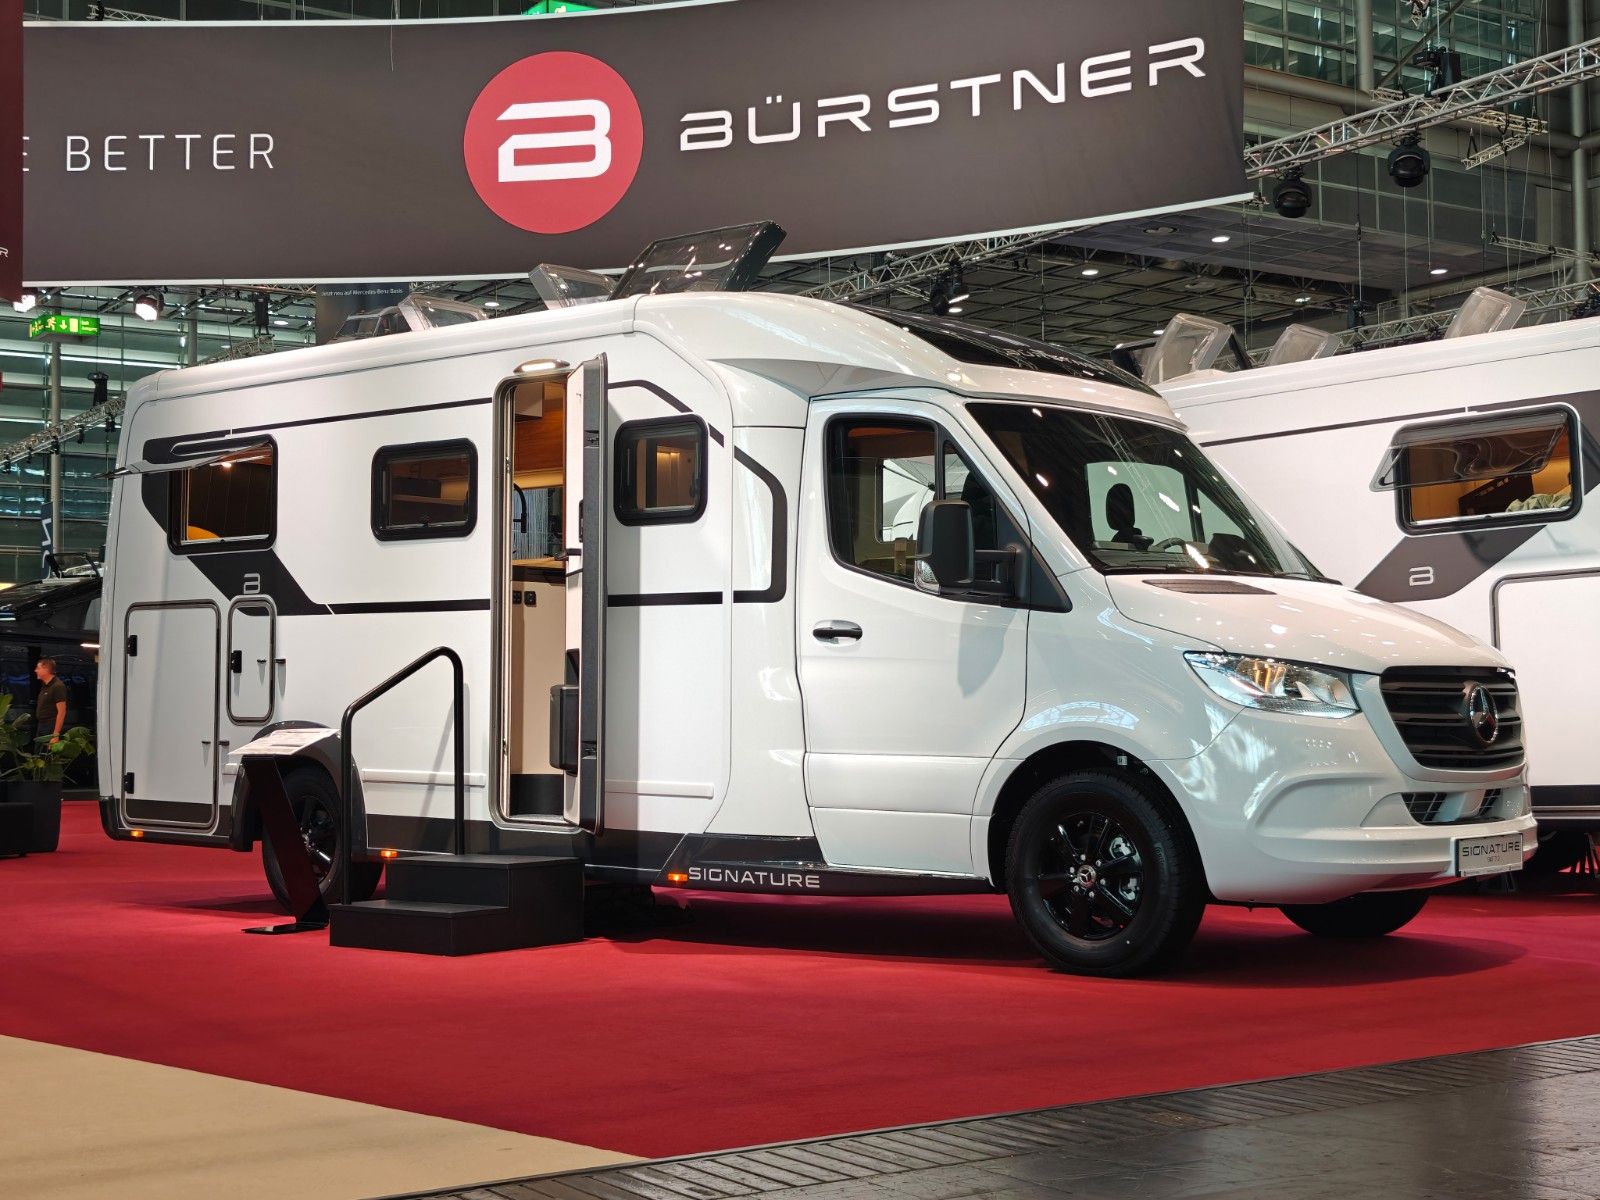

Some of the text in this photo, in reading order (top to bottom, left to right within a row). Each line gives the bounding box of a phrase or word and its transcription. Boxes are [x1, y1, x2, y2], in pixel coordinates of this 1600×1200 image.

[681, 38, 1205, 151] BÜRSTNER
[67, 134, 273, 171] BETTER
[1462, 841, 1520, 857] SIGNATURE
[688, 867, 821, 889] SIGNATURE
